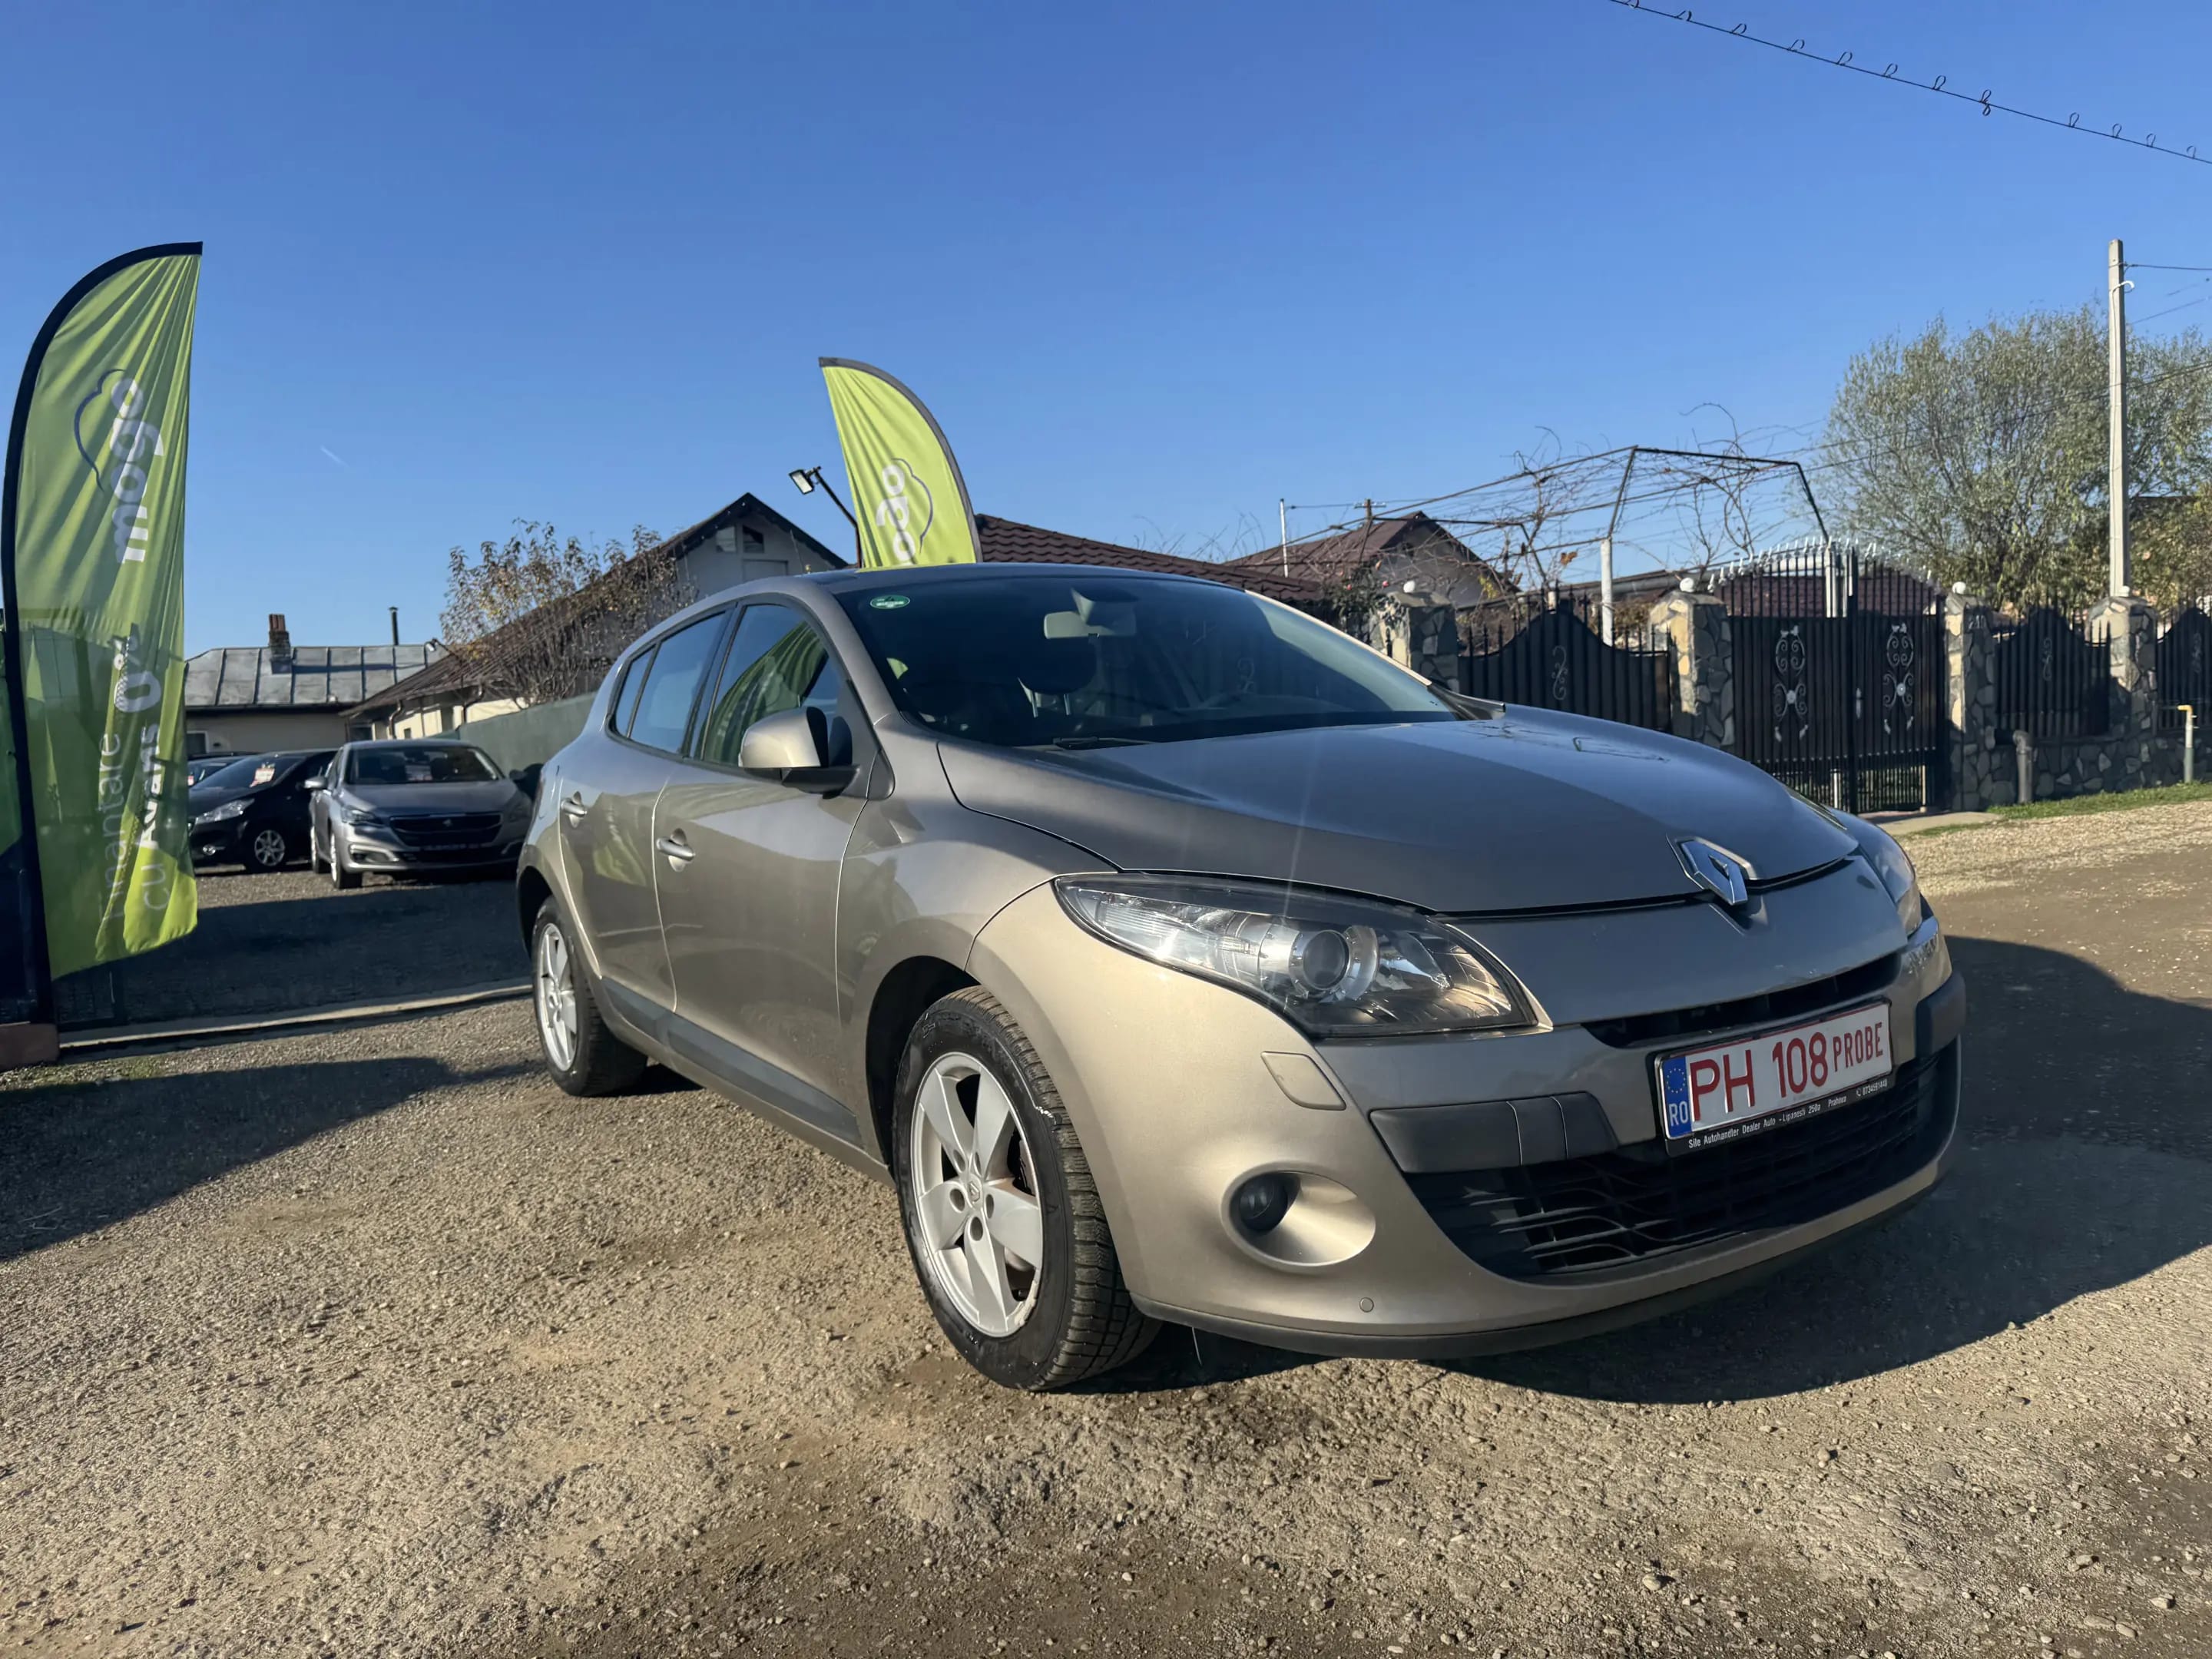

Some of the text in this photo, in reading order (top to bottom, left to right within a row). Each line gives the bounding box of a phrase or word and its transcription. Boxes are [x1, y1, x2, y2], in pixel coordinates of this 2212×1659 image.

[110, 378, 164, 565] mogo
[141, 863, 171, 912] cu
[1690, 1022, 1884, 1121] PH 108 PROBE
[1668, 1100, 1689, 1127] RO
[1704, 1127, 1740, 1146] Autohandler
[1742, 1121, 1761, 1134] Dealer
[1763, 1117, 1777, 1129] Auto
